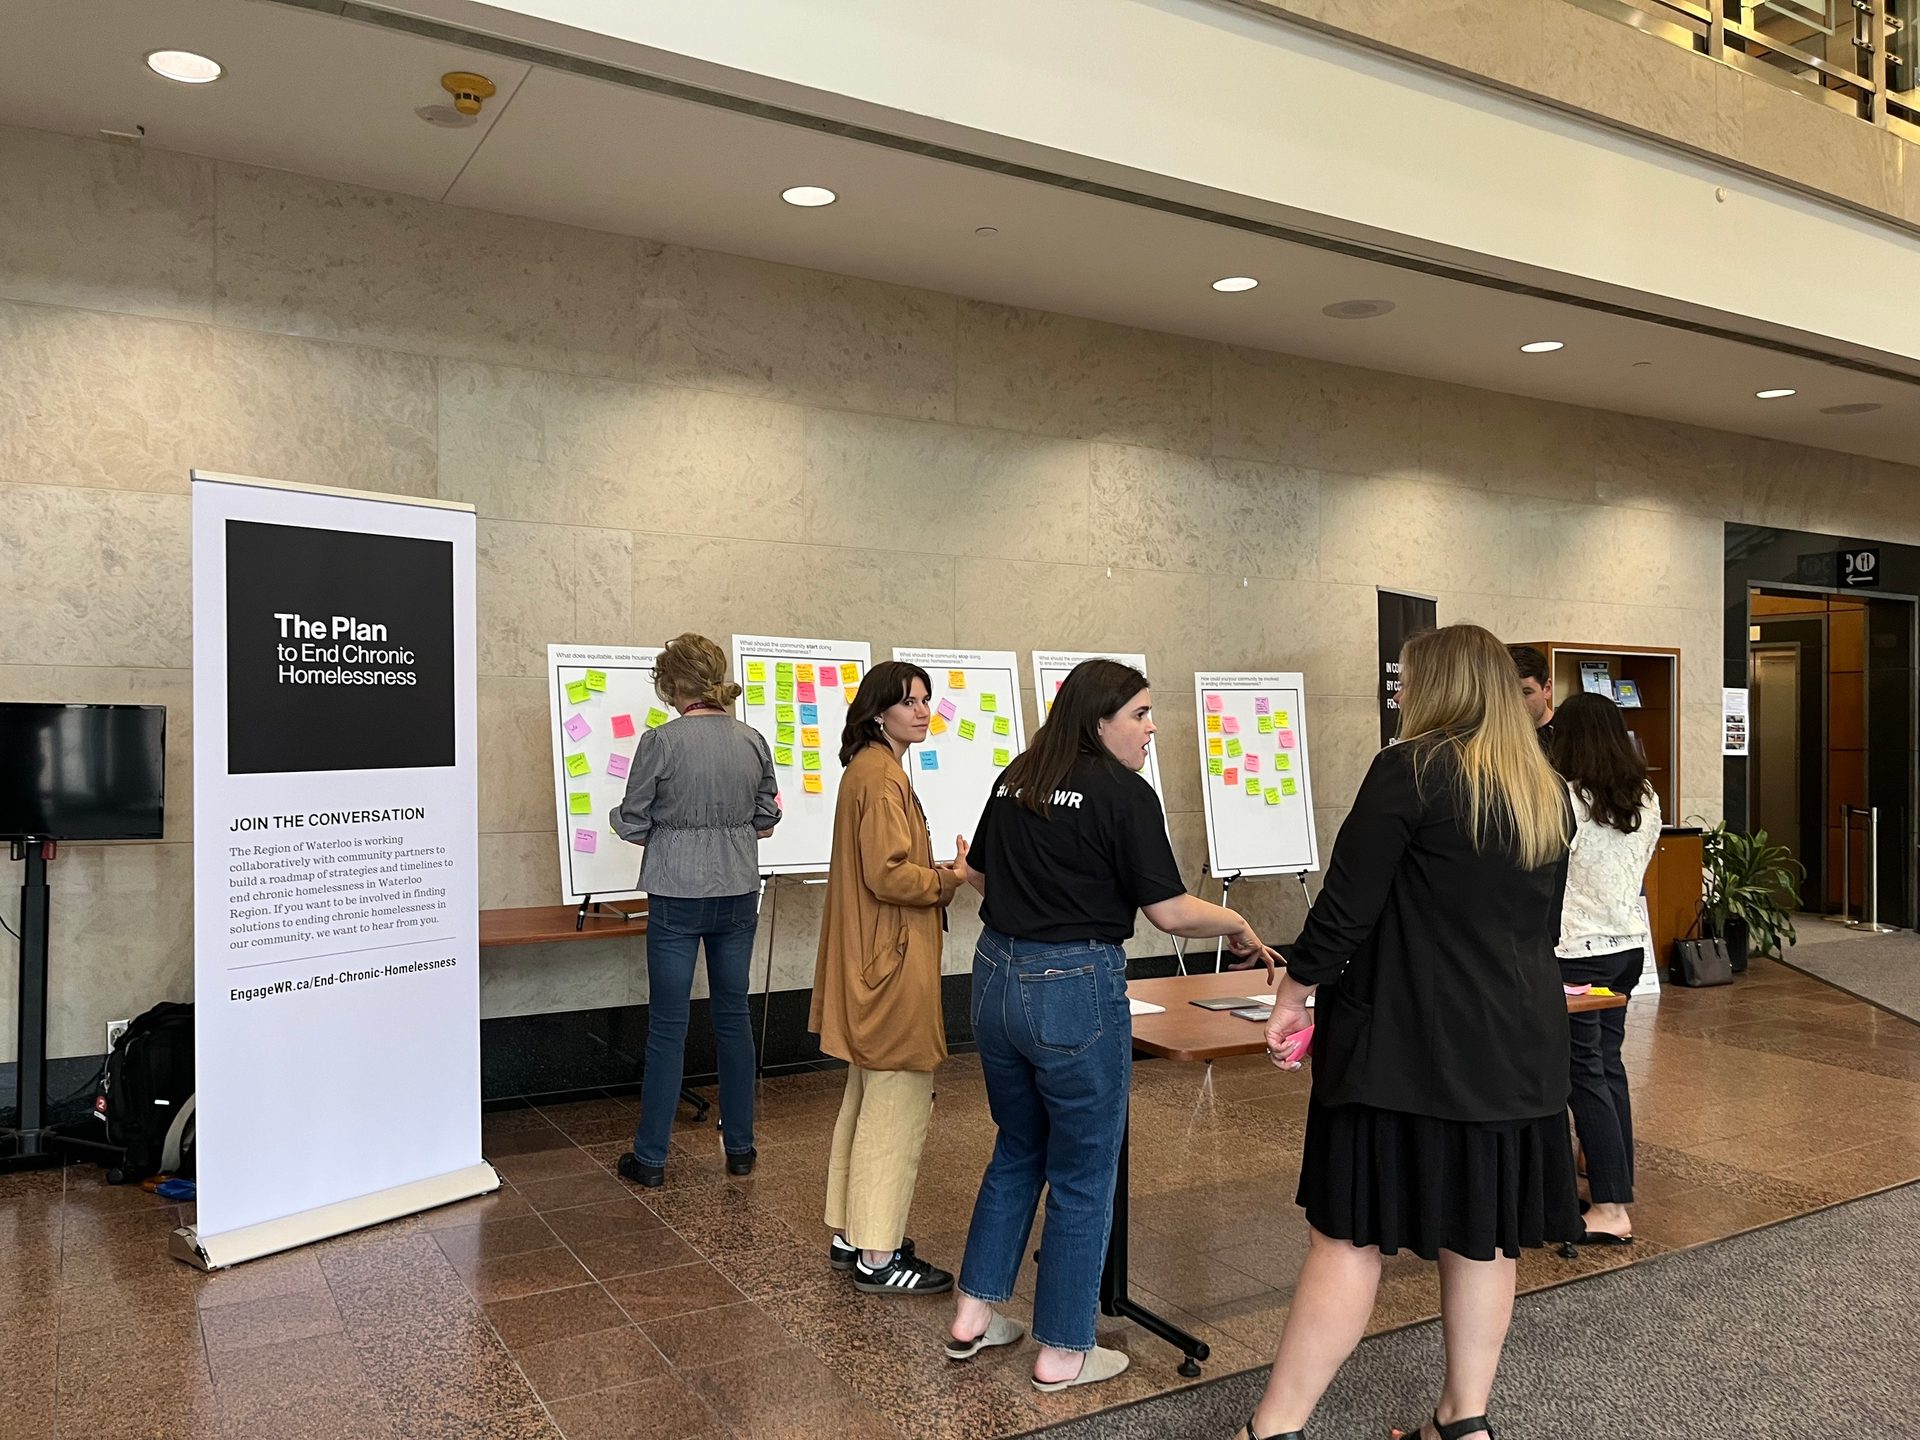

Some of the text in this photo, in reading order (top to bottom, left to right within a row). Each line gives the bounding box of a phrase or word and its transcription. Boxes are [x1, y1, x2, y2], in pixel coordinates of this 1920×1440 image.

[274, 613, 387, 641] The Plan
[277, 643, 414, 664] to End Chronic
[279, 665, 417, 686] Homelessness
[230, 807, 425, 832] JOIN THE CONVERSATION
[229, 835, 404, 858] The Region of Waterloo is working
[229, 846, 445, 873] collaboratively with community partners to
[229, 876, 257, 888] build
[269, 872, 315, 884] roadmap
[317, 869, 328, 879] of
[328, 865, 378, 878] strategies
[380, 864, 398, 873] and
[400, 859, 443, 871] timelines
[444, 859, 453, 867] to
[230, 875, 423, 903] end chronic homelessness in Waterloo
[230, 887, 446, 921] Region. If you want to be involved in finding
[230, 900, 446, 934] solutions to ending chronic homelessness in
[230, 940, 249, 950] our
[317, 930, 331, 938] we
[333, 926, 358, 935] want
[360, 924, 370, 933] to
[372, 920, 394, 931] hear
[396, 918, 418, 928] from
[420, 916, 439, 927] you.
[230, 957, 457, 1001] EngageWR.ca/End-Chronic-Homelessness
